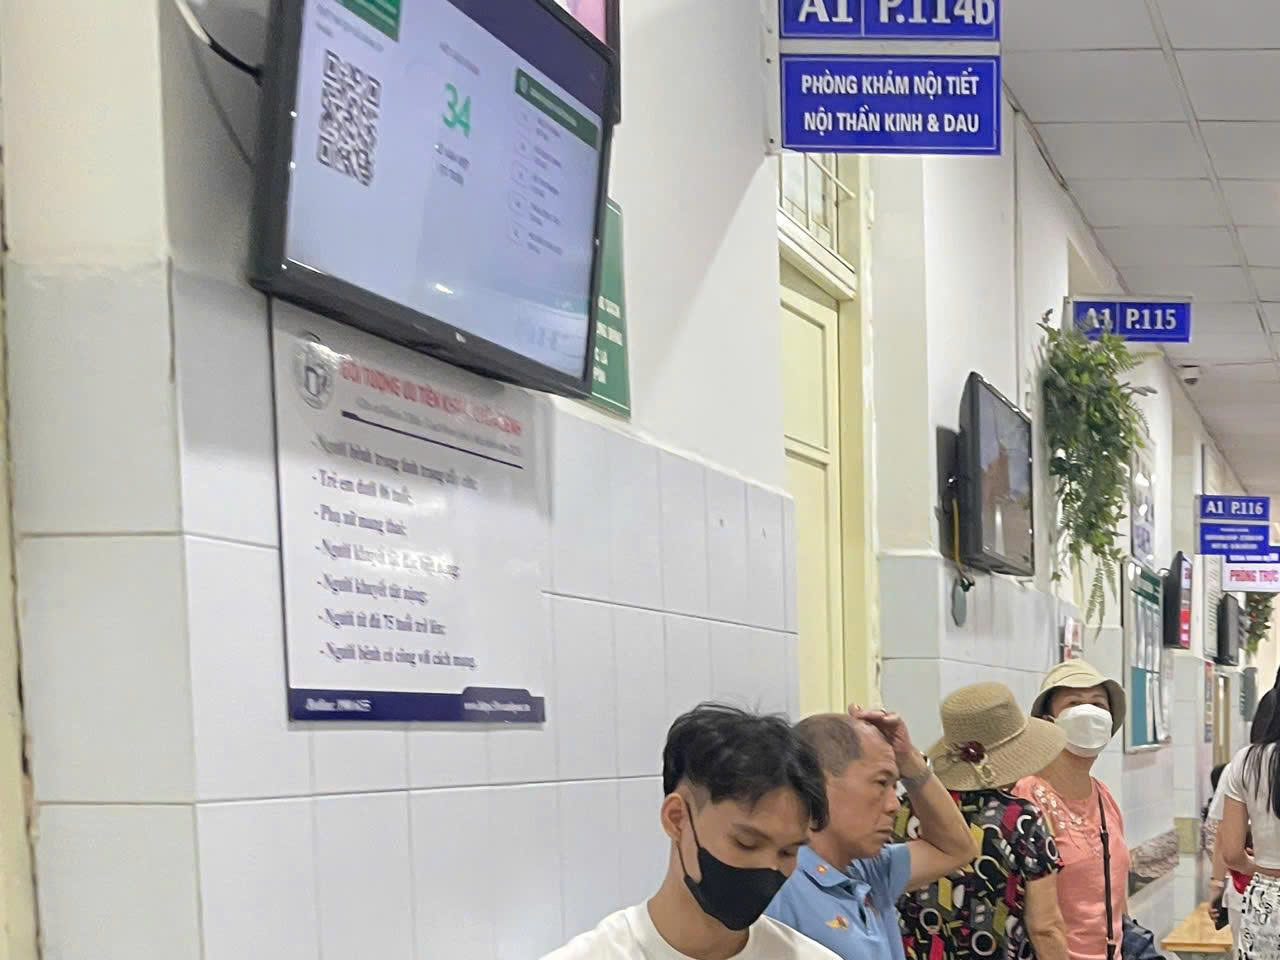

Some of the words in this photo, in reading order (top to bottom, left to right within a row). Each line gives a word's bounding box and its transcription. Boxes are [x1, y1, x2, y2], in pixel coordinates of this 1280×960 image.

[797, 0, 853, 23] A1
[802, 69, 858, 95] PHÒNG
[862, 69, 909, 95] KHÁM
[913, 71, 942, 100] NỘI
[946, 67, 979, 96] TIẾT
[442, 82, 472, 138] 34
[804, 107, 832, 136] NỘI
[836, 105, 880, 132] THẦN
[884, 113, 922, 132] KINH
[927, 114, 940, 132] &
[1086, 307, 1113, 329] A1
[1126, 308, 1177, 330] P.115
[1205, 501, 1224, 514] A1
[1231, 502, 1264, 515] P.116
